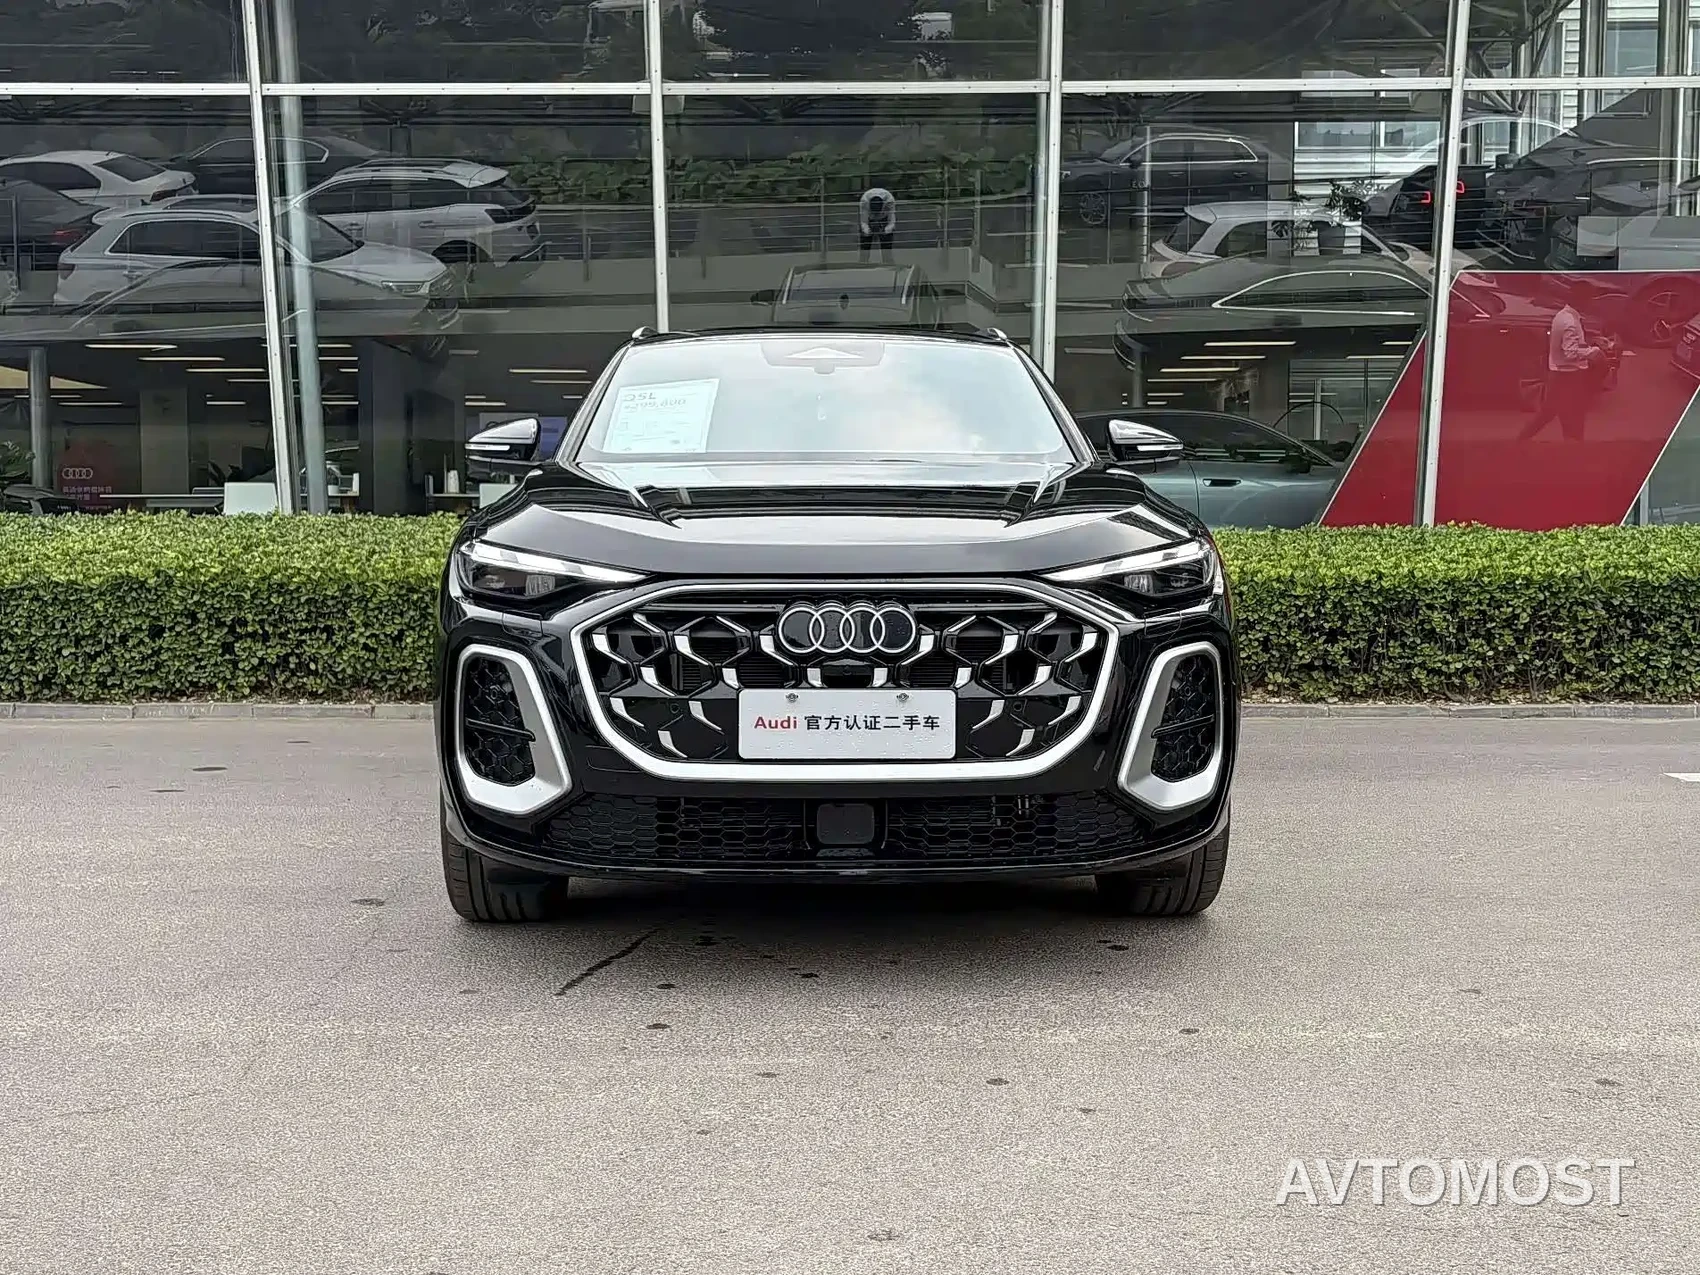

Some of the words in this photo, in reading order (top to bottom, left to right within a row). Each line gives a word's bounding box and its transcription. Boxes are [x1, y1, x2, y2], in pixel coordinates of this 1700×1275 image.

[754, 715, 798, 730] Audi
[804, 714, 941, 731] 官方认证二手车
